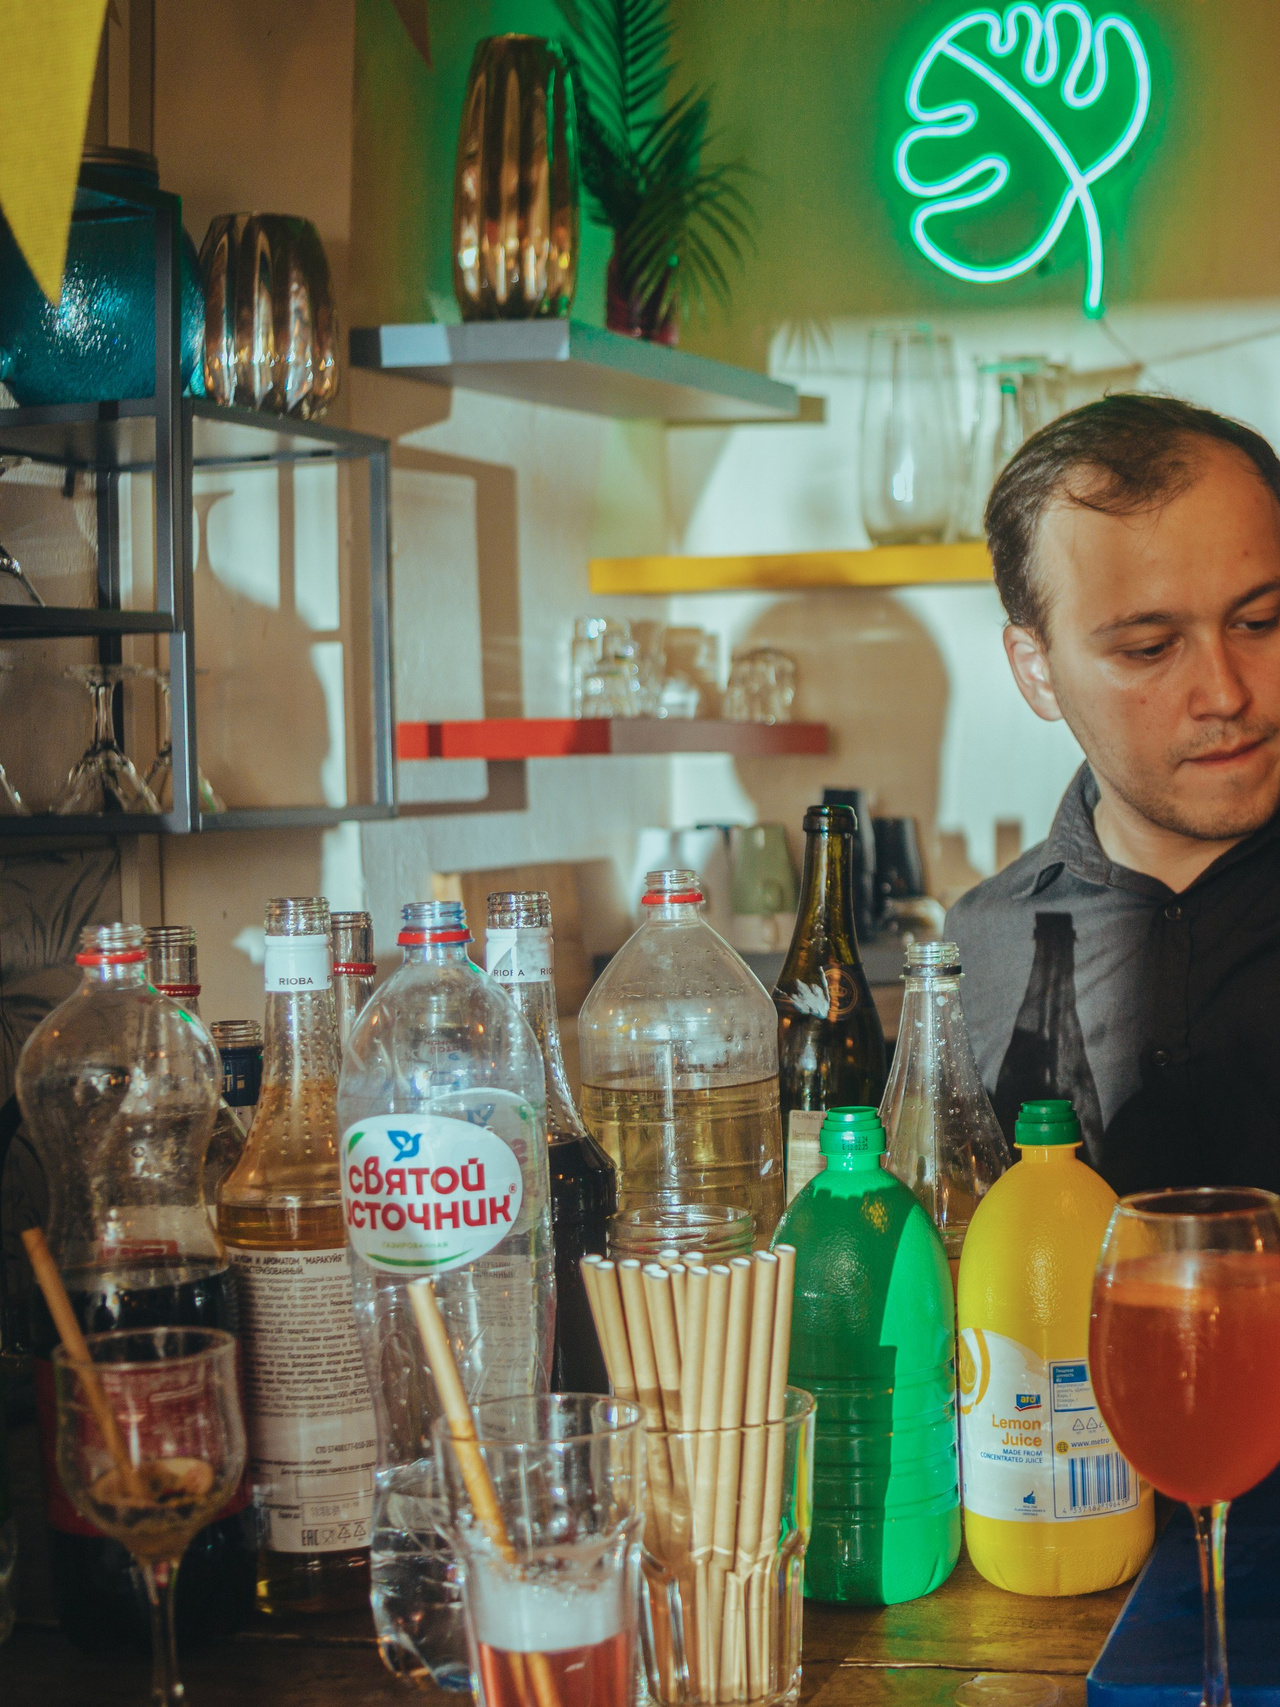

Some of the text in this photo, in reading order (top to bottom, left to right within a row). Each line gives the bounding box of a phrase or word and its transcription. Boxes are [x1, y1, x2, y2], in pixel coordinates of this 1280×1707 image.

[278, 977, 314, 986] RIOBA
[262, 1256, 301, 1266] АРОМАТОМ
[1020, 1396, 1036, 1404] aro
[992, 1413, 1042, 1431] Lemon
[1002, 1432, 1043, 1447] Juice
[980, 1451, 1024, 1463] CONCENTRATED
